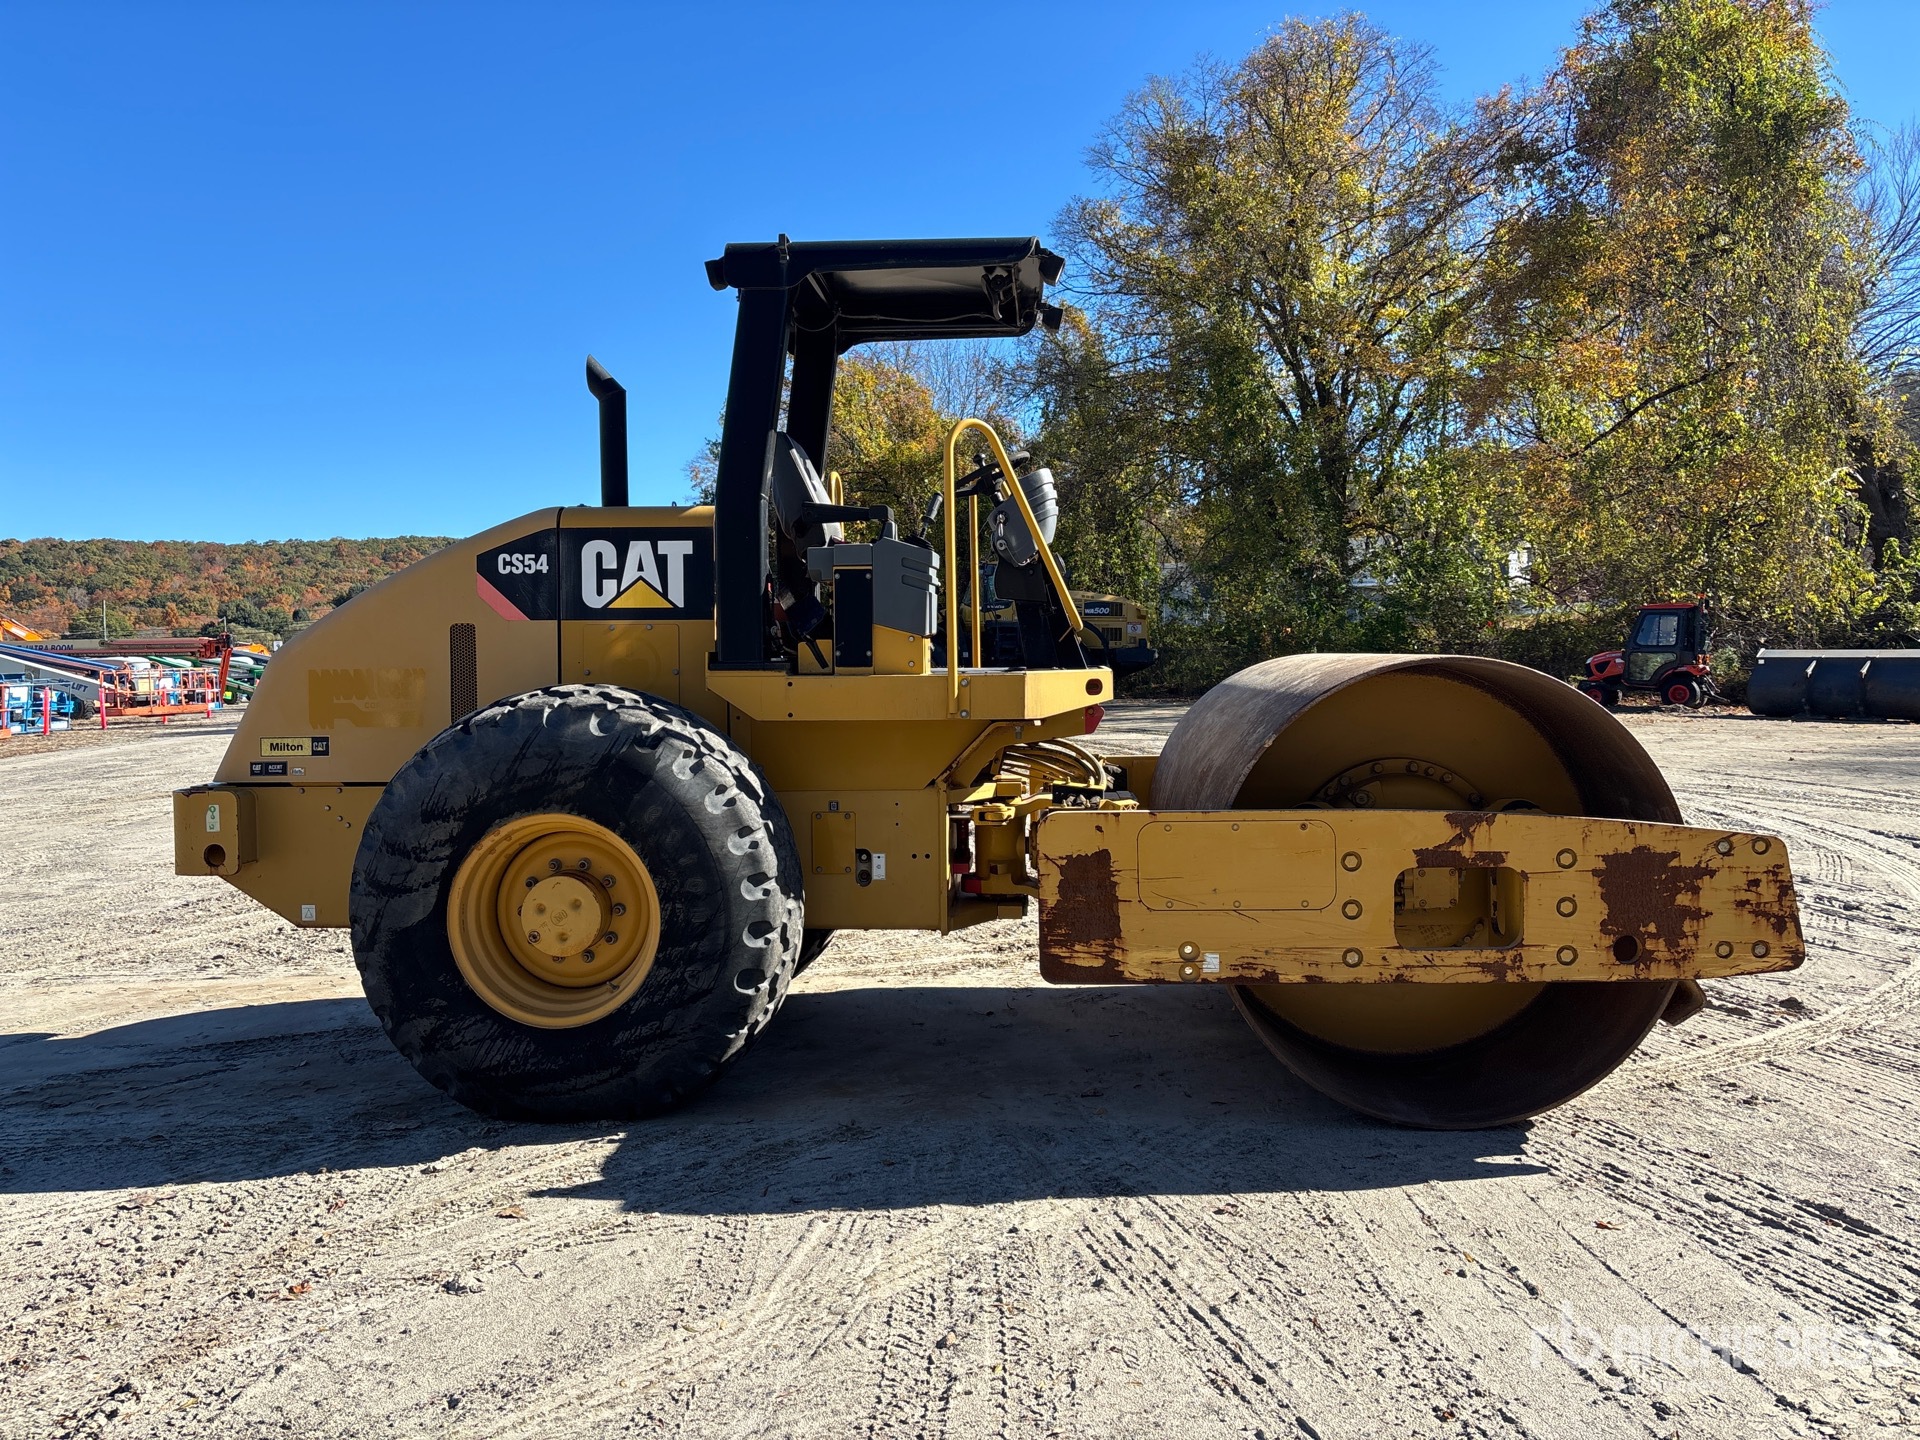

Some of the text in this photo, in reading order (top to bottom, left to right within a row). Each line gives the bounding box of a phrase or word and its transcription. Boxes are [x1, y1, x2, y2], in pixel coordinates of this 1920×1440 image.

[497, 553, 549, 574] CS54
[581, 539, 693, 609] CAT
[71, 682, 89, 692] LIFT
[269, 741, 327, 752] Milton CAT
